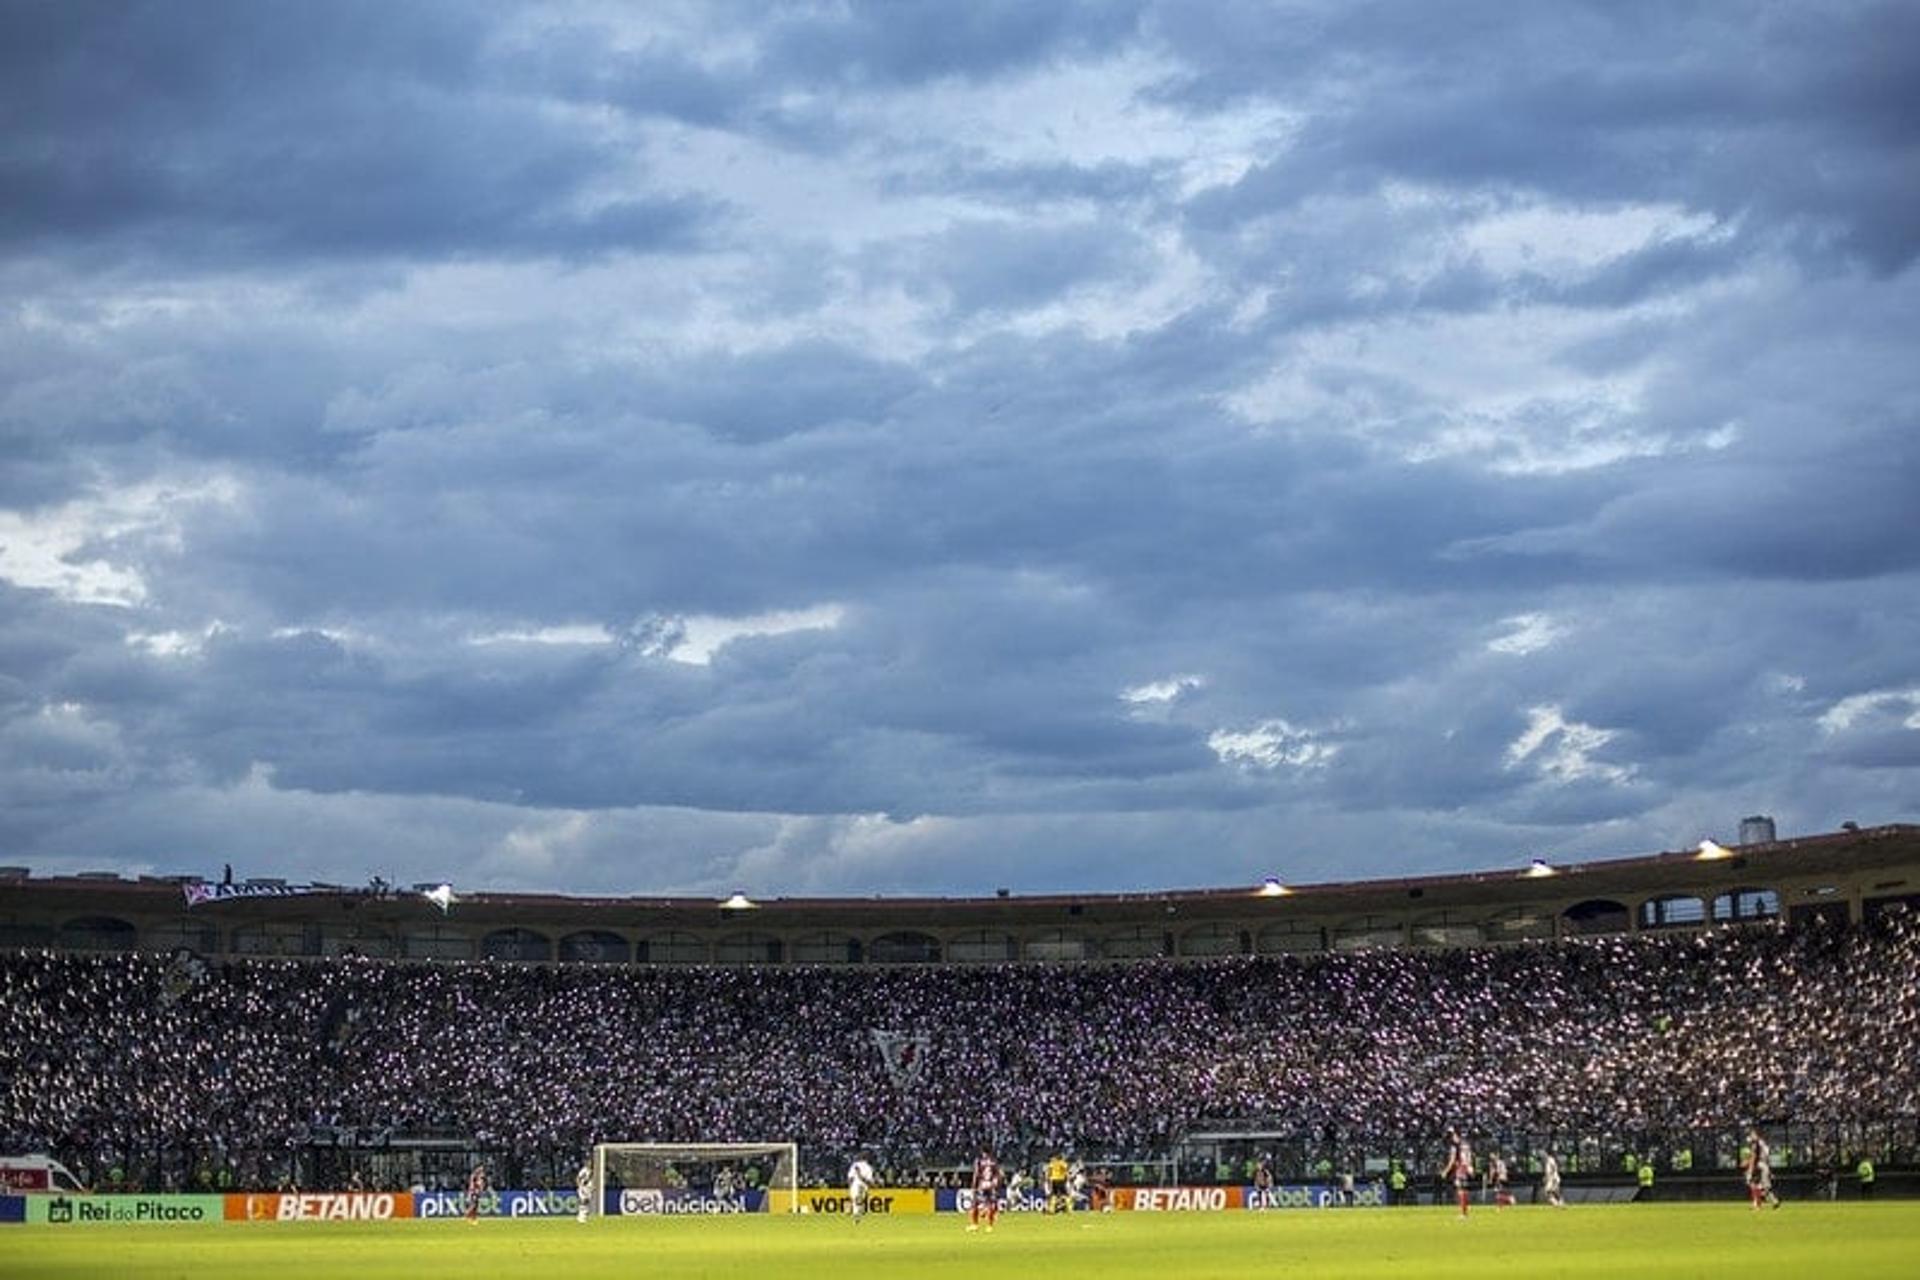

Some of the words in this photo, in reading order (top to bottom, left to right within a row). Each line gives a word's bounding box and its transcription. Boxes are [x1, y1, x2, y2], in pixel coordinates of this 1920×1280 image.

[79, 1202, 111, 1220] Rei
[113, 1206, 134, 1220] do
[136, 1202, 204, 1220] Pitaco
[276, 1194, 395, 1220] BETANO
[511, 1191, 578, 1218] pixbe
[1134, 1188, 1226, 1211] BETANO
